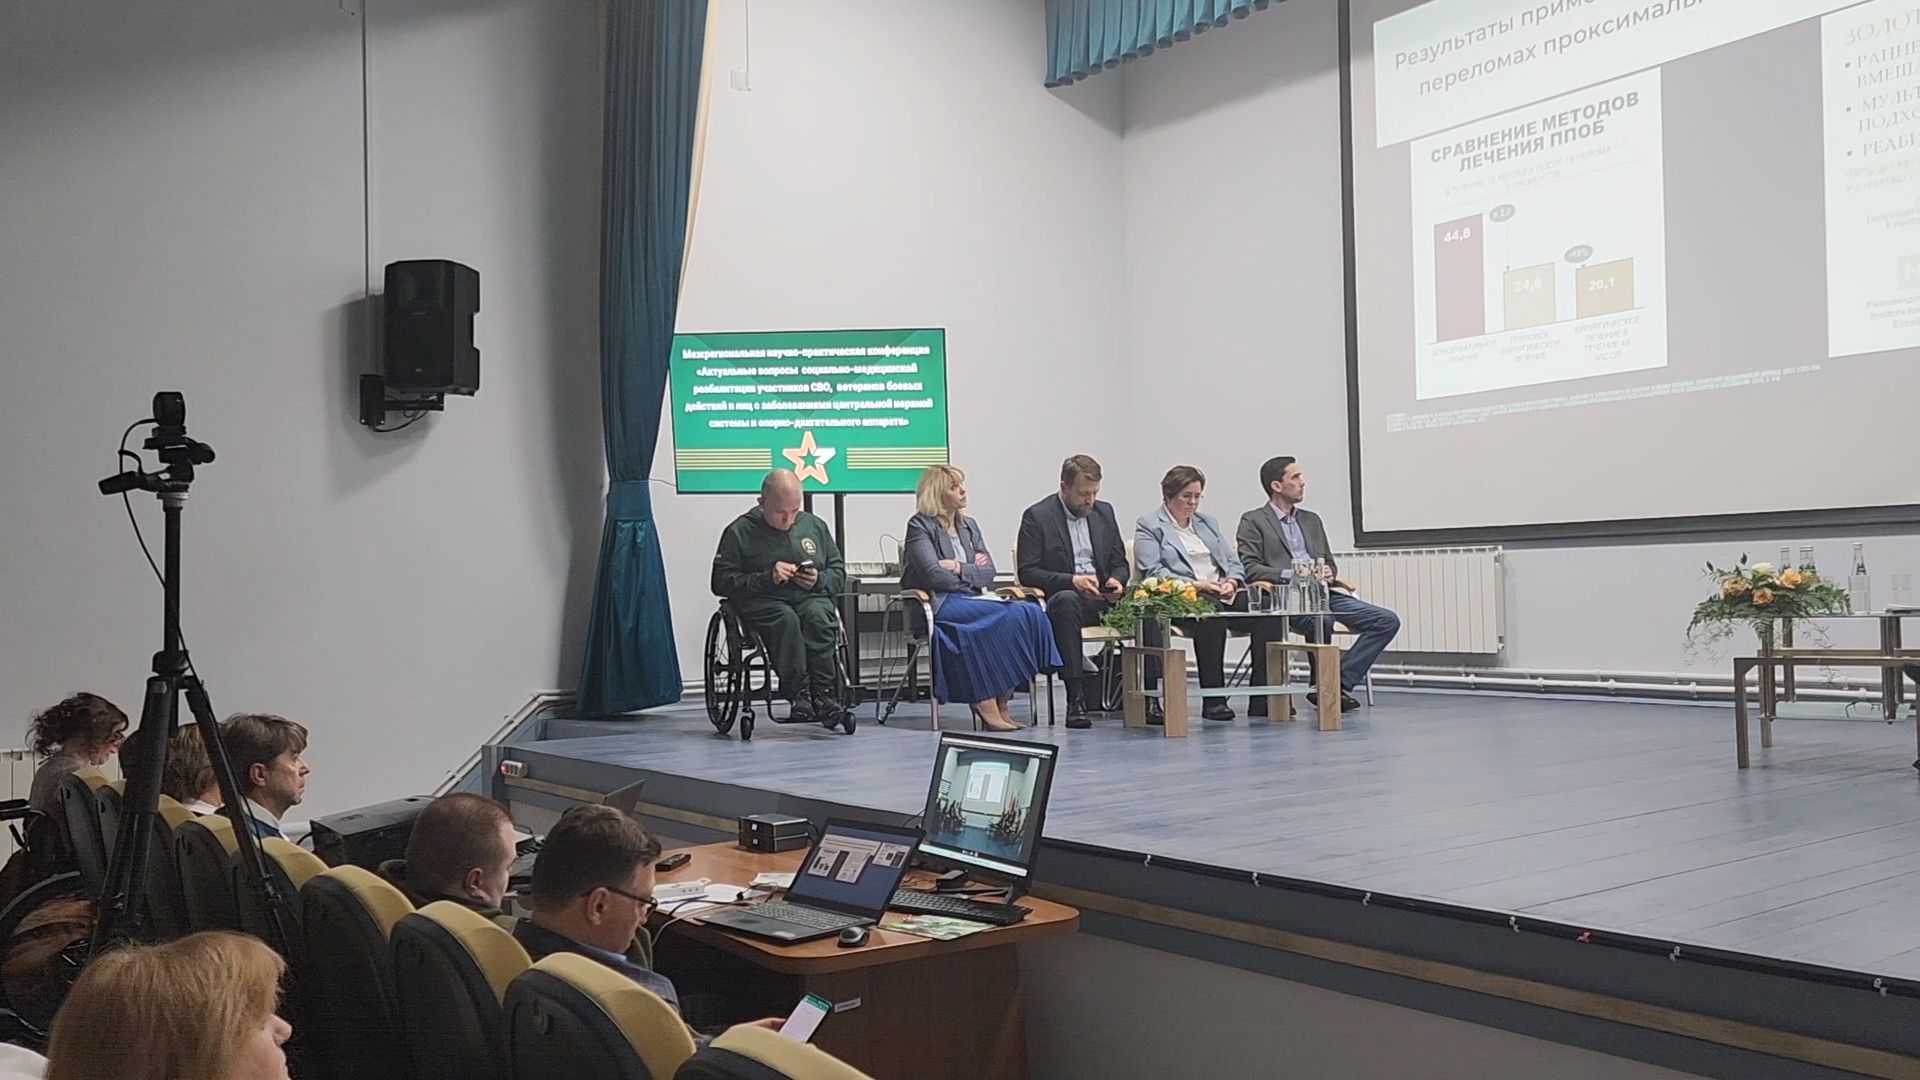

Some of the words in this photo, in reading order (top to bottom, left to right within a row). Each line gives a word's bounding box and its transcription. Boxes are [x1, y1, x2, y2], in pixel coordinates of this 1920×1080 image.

[1395, 17, 1513, 70] Результаты
[1420, 45, 1537, 95] переломах
[1543, 0, 1703, 54] проксималь
[1431, 121, 1537, 163] СРАВНЕНИЕ
[1542, 91, 1639, 132] МЕТОДОВ
[1459, 137, 1545, 172] ЛЕЧЕНИЯ
[1550, 120, 1605, 148] ППОБ
[1443, 227, 1471, 243] 44,8
[1514, 277, 1544, 292] 24,8
[1588, 276, 1616, 291] 20,1
[682, 349, 766, 360] Межрегиональная
[767, 347, 866, 359] научно-практическая
[867, 345, 930, 357] конференция
[696, 366, 757, 378] «Актуальные
[758, 366, 799, 377] вопросы
[801, 362, 918, 375] социально-медицинской
[693, 383, 756, 395] реабилитации
[757, 383, 809, 394] участников
[810, 381, 833, 393] СВО,
[836, 382, 885, 392] ветеранов
[886, 380, 923, 391] боевых
[685, 400, 727, 412] действий
[728, 402, 735, 410] и
[735, 402, 753, 411] лиц
[754, 402, 760, 410] с
[761, 400, 832, 410] заболеваниями
[833, 398, 893, 411] центральной
[893, 397, 934, 410] нервной
[708, 419, 750, 428] системы
[750, 419, 757, 428] и
[758, 418, 861, 429] опорно-двигательного
